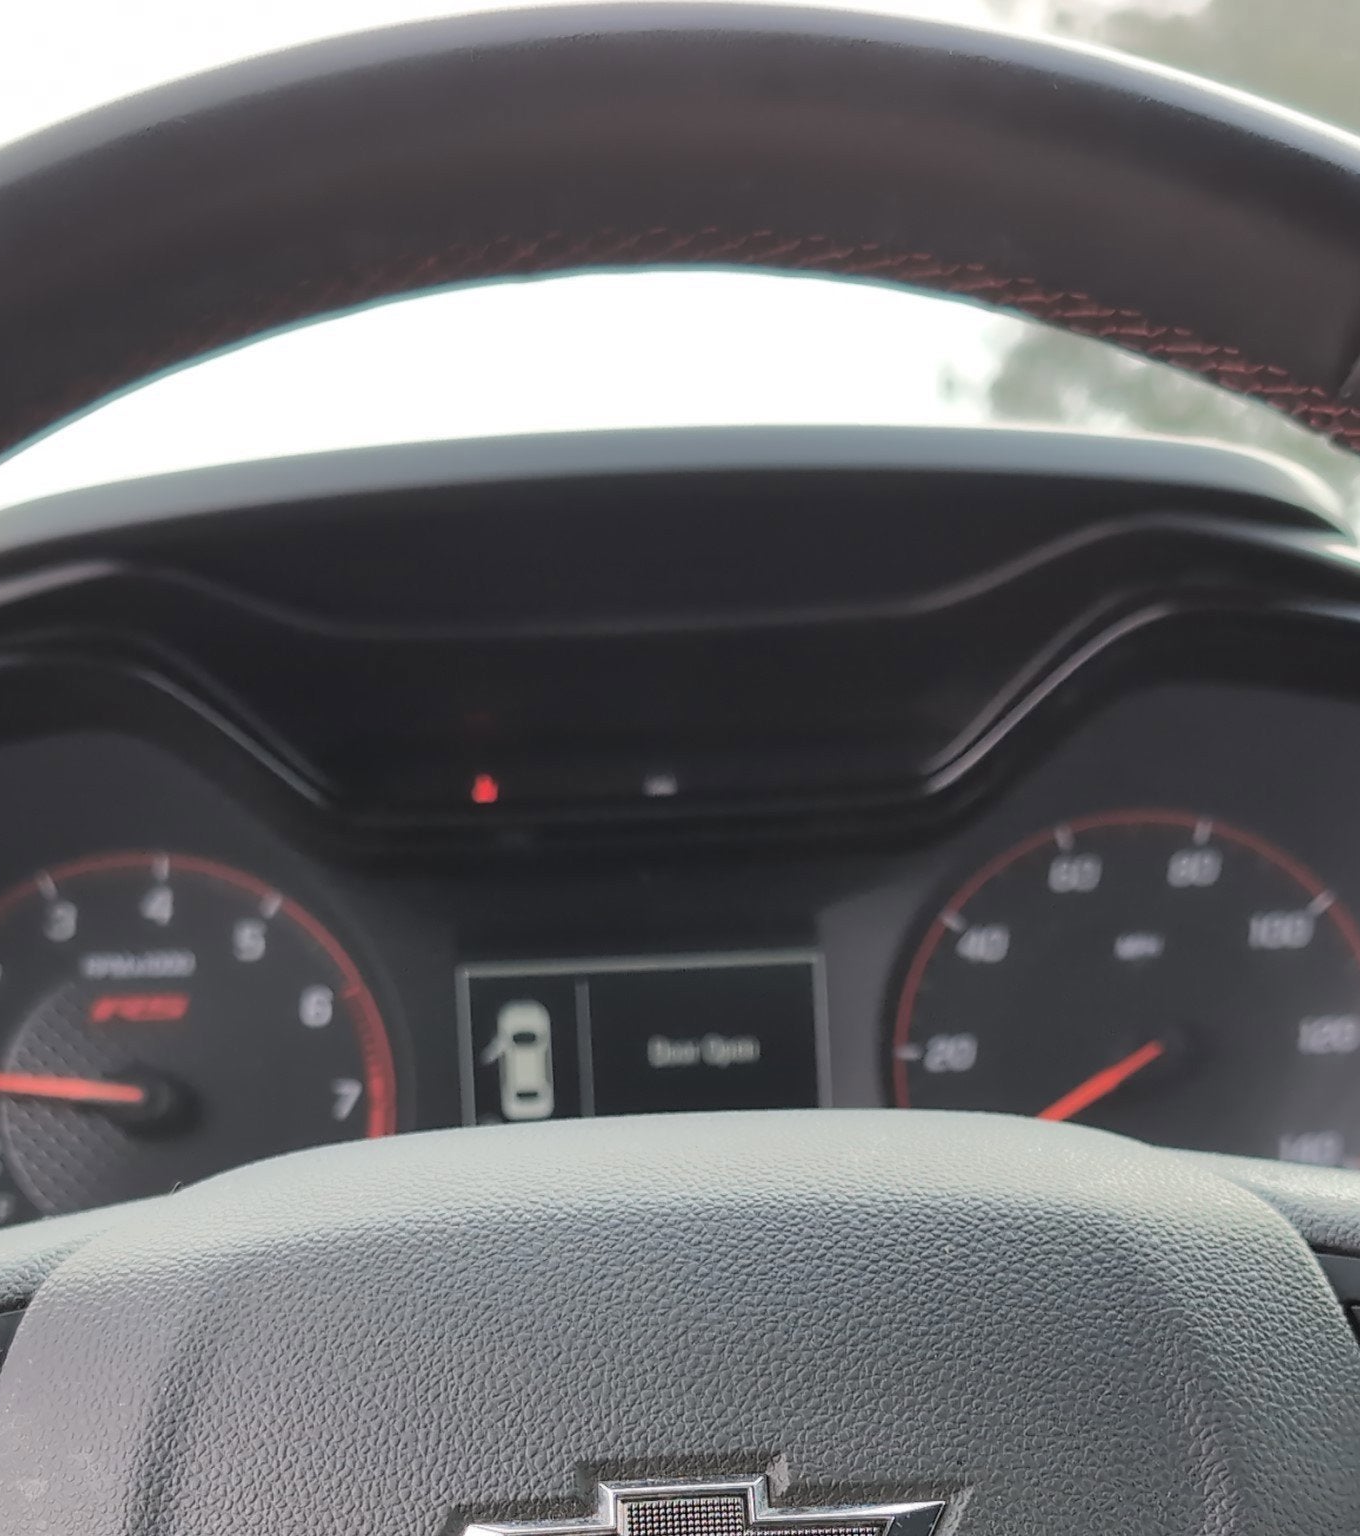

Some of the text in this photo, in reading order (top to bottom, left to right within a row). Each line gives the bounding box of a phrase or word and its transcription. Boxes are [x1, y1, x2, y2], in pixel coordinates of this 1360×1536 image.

[45, 900, 78, 942] 3
[142, 885, 174, 926] 4
[233, 919, 267, 963] 5
[299, 984, 334, 1028] 6
[331, 1077, 363, 1121] 7
